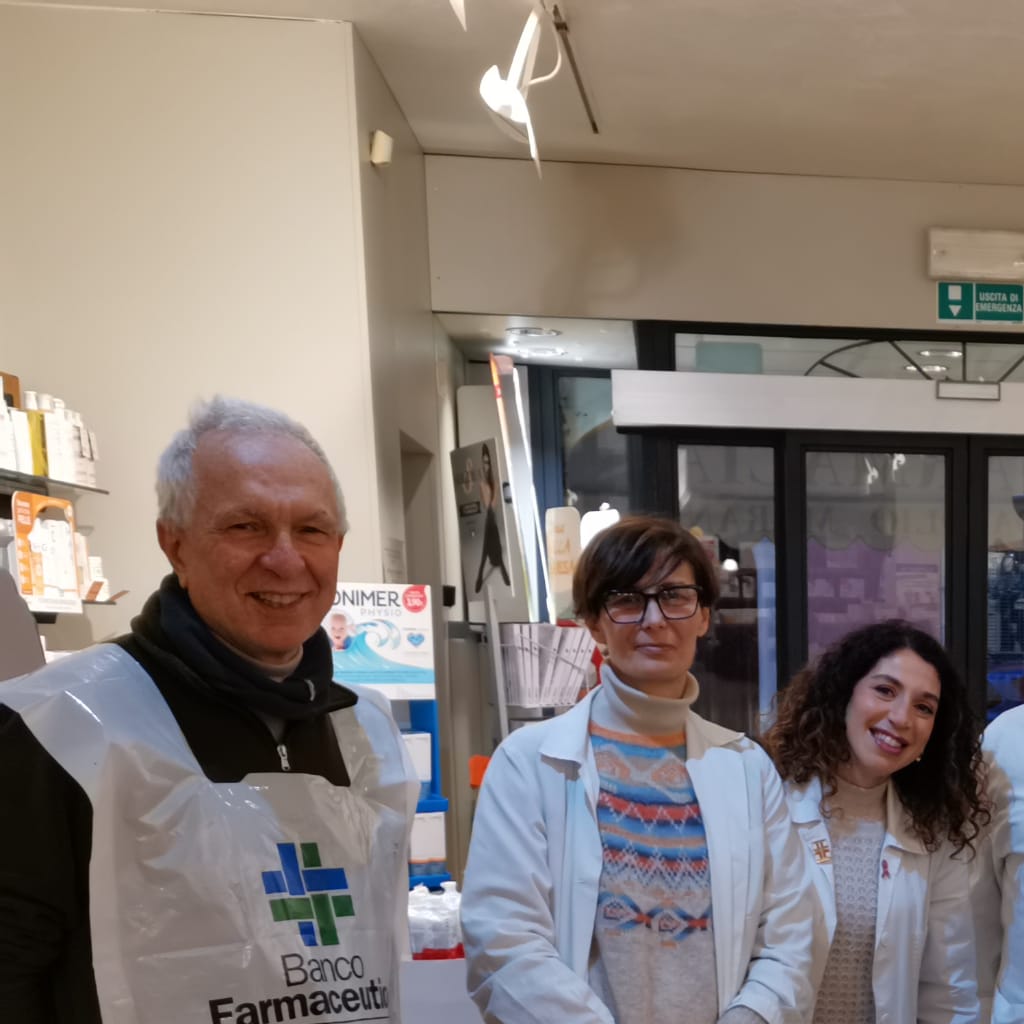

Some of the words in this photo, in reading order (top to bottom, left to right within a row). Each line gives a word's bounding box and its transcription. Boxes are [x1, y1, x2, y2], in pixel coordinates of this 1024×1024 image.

[979, 291, 1008, 302] USCITA
[1009, 293, 1019, 302] DI
[975, 302, 1022, 313] EMERGENZA
[360, 608, 402, 617] PHYSIO
[280, 953, 365, 988] Banco
